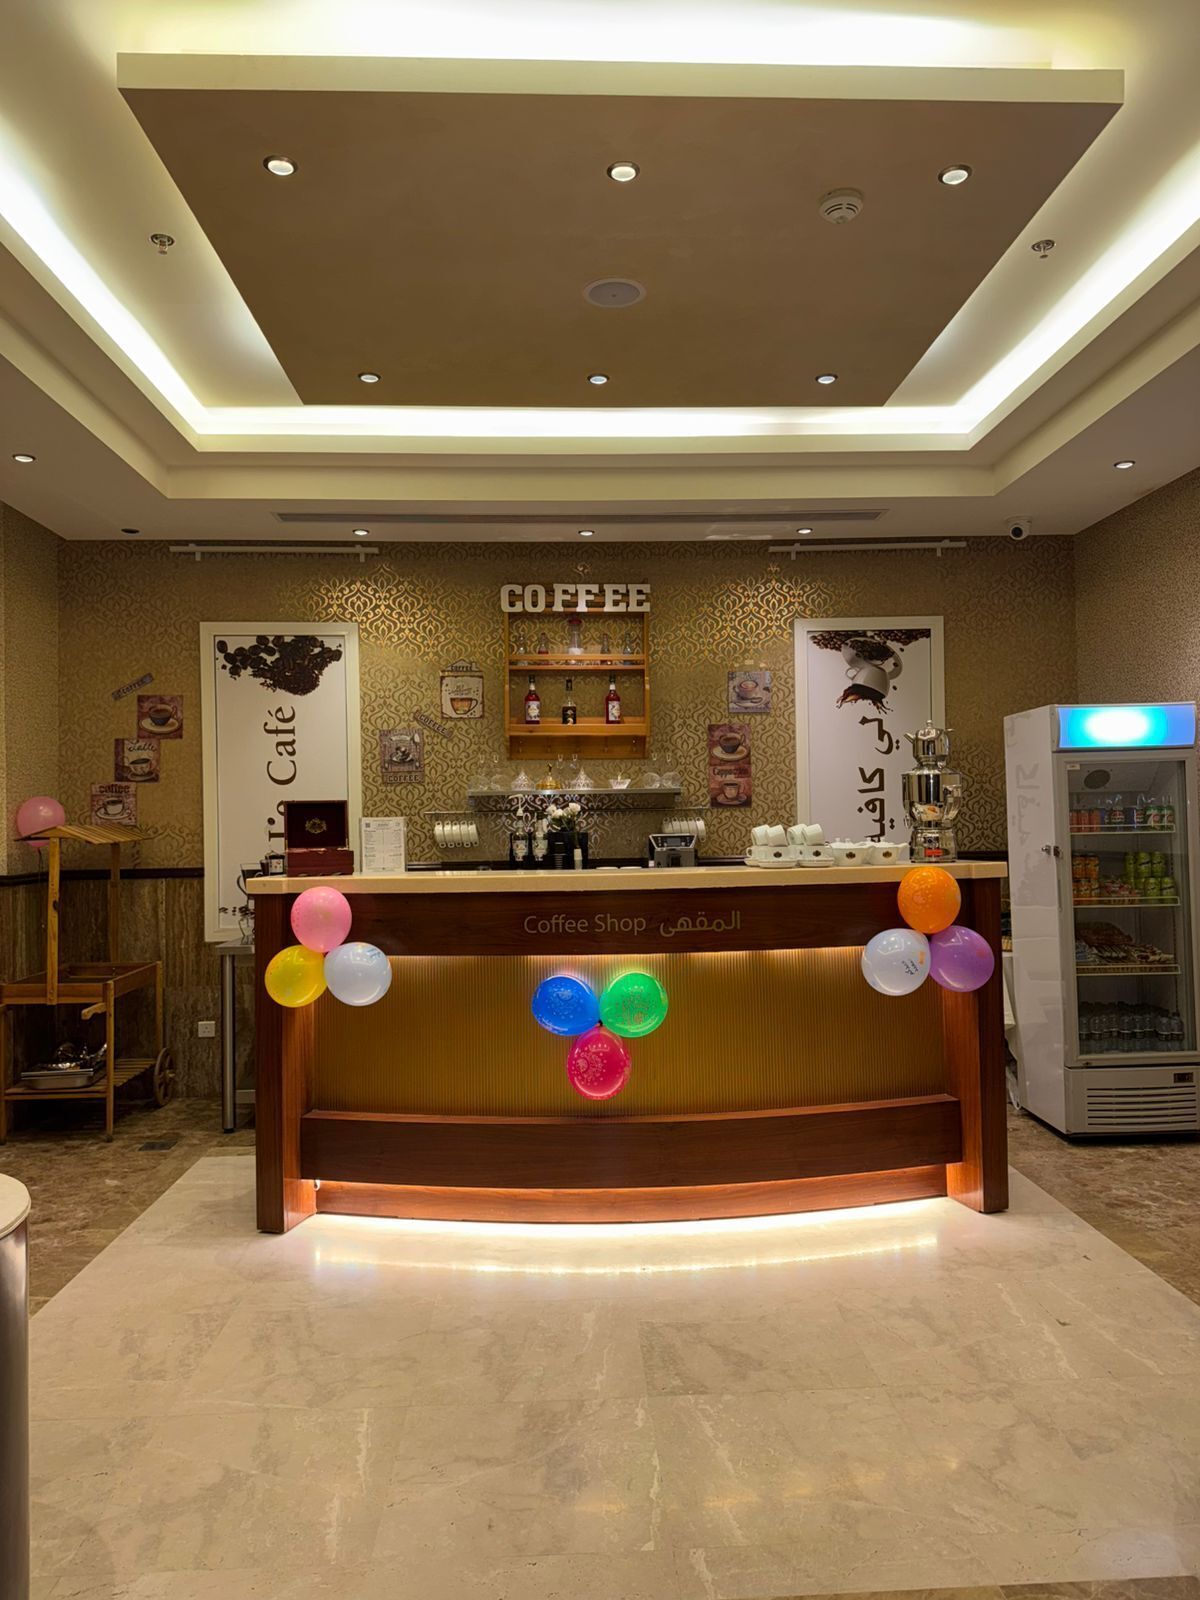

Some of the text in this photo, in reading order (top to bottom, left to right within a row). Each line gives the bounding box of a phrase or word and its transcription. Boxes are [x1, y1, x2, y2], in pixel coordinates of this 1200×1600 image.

[500, 583, 651, 613] COFFEE
[419, 714, 448, 734] COFFEE
[858, 715, 900, 755] لي
[263, 706, 297, 786] Café
[388, 774, 419, 782] COFFEE
[523, 913, 646, 936] Coffee Shop
[660, 910, 742, 937] المقهى
